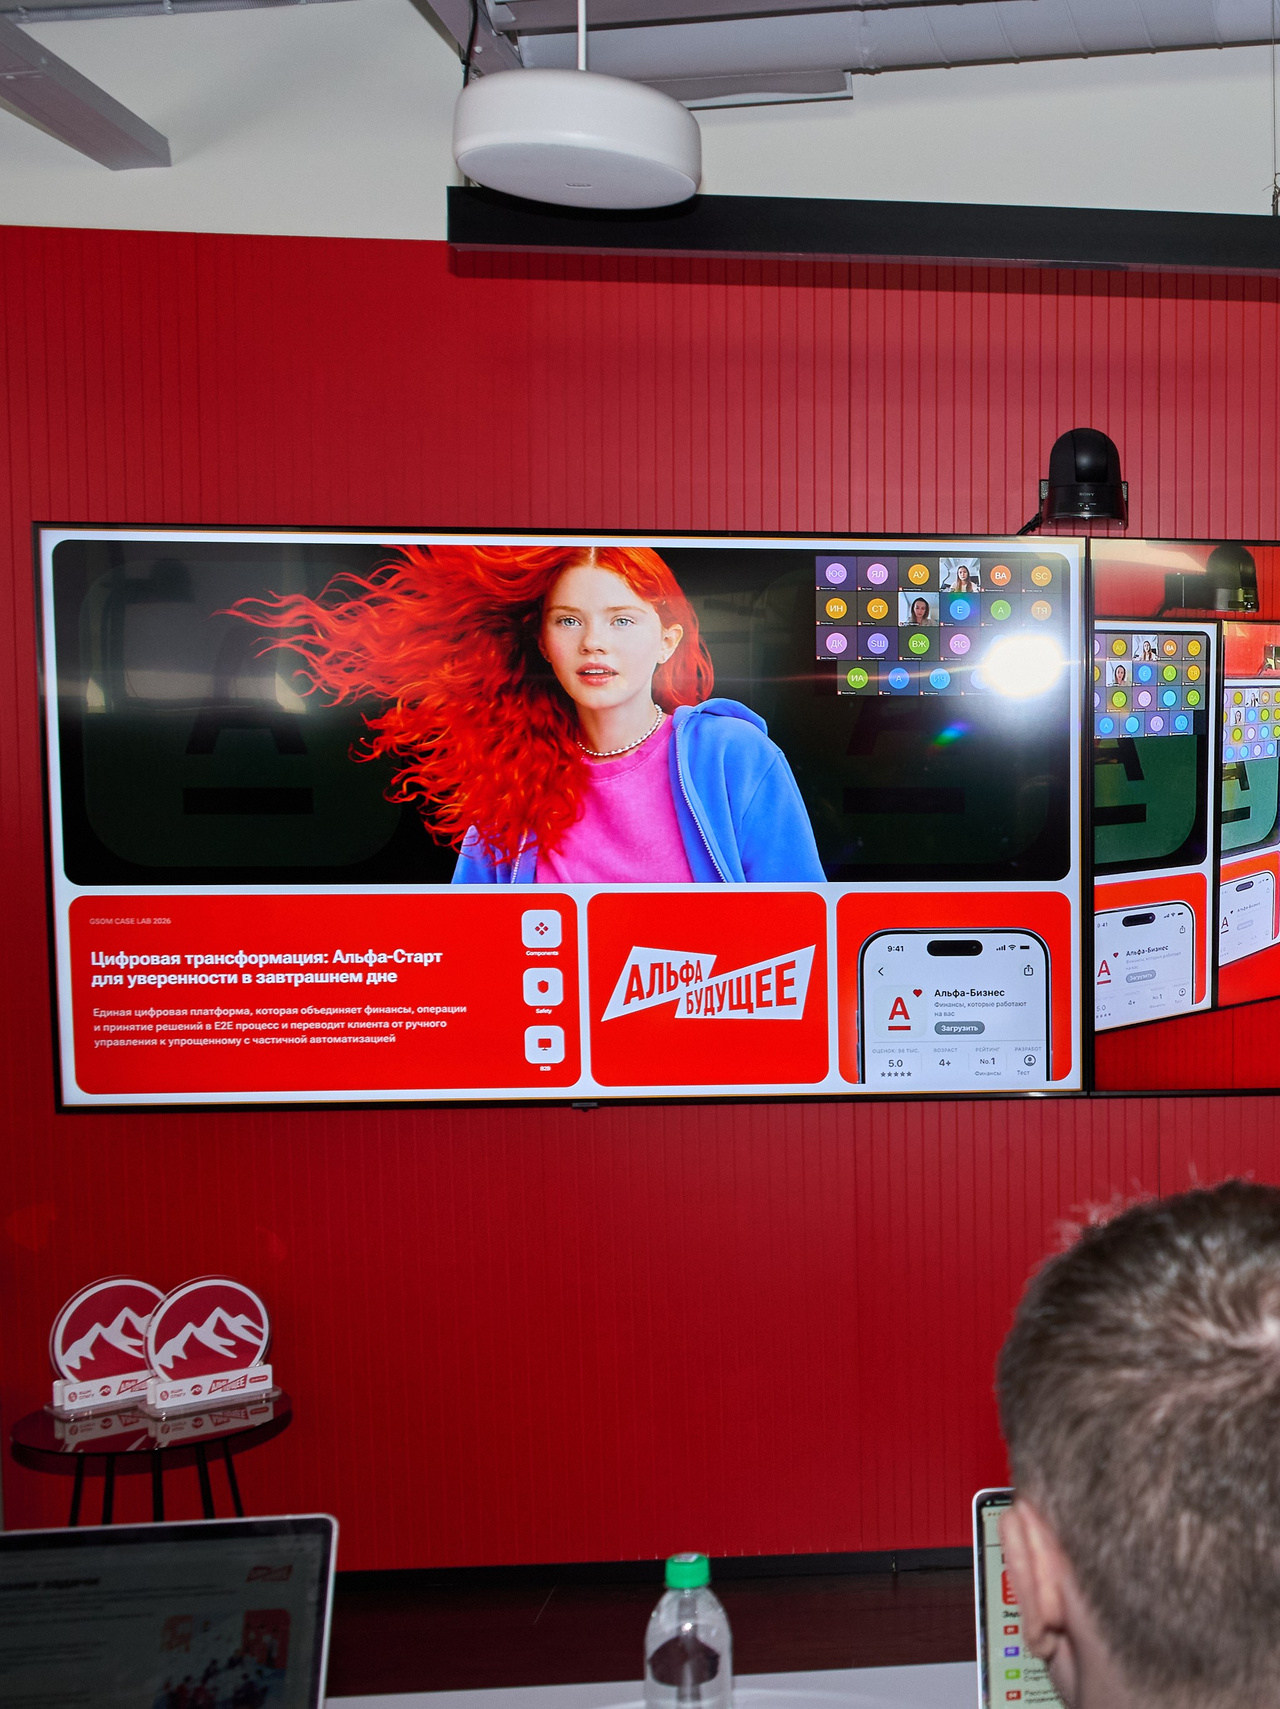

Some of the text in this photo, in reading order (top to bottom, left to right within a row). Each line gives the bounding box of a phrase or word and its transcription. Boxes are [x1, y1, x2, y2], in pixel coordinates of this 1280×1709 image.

[153, 917, 171, 925] 2026
[91, 948, 443, 970] Цифровая трансформация: Альфа-Старт
[91, 972, 398, 989] для уверенности в завтрашнем дне
[623, 960, 703, 1006] АЛЬФА
[686, 959, 797, 1017] БУДУЩЕЕ
[934, 988, 1005, 998] Альфа-Бизнес
[93, 1005, 467, 1018] Единая цифровая платформа, которая объединяет финансы, операции
[93, 1024, 101, 1032] и
[103, 1023, 153, 1032] принятие
[155, 1021, 203, 1033] решений
[235, 1022, 279, 1032] процесс
[290, 1020, 345, 1031] переводит
[347, 1020, 389, 1029] клиента
[391, 1020, 403, 1028] от
[405, 1020, 447, 1030] ручного
[941, 1024, 979, 1033] Загрузить
[94, 1038, 157, 1048] управления
[168, 1037, 241, 1047] упрощенному
[252, 1035, 307, 1045] частичной
[309, 1034, 396, 1044] автоматизацией
[888, 1059, 904, 1067] 5.0
[938, 1059, 951, 1067] 4+
[979, 1057, 996, 1065] No.1
